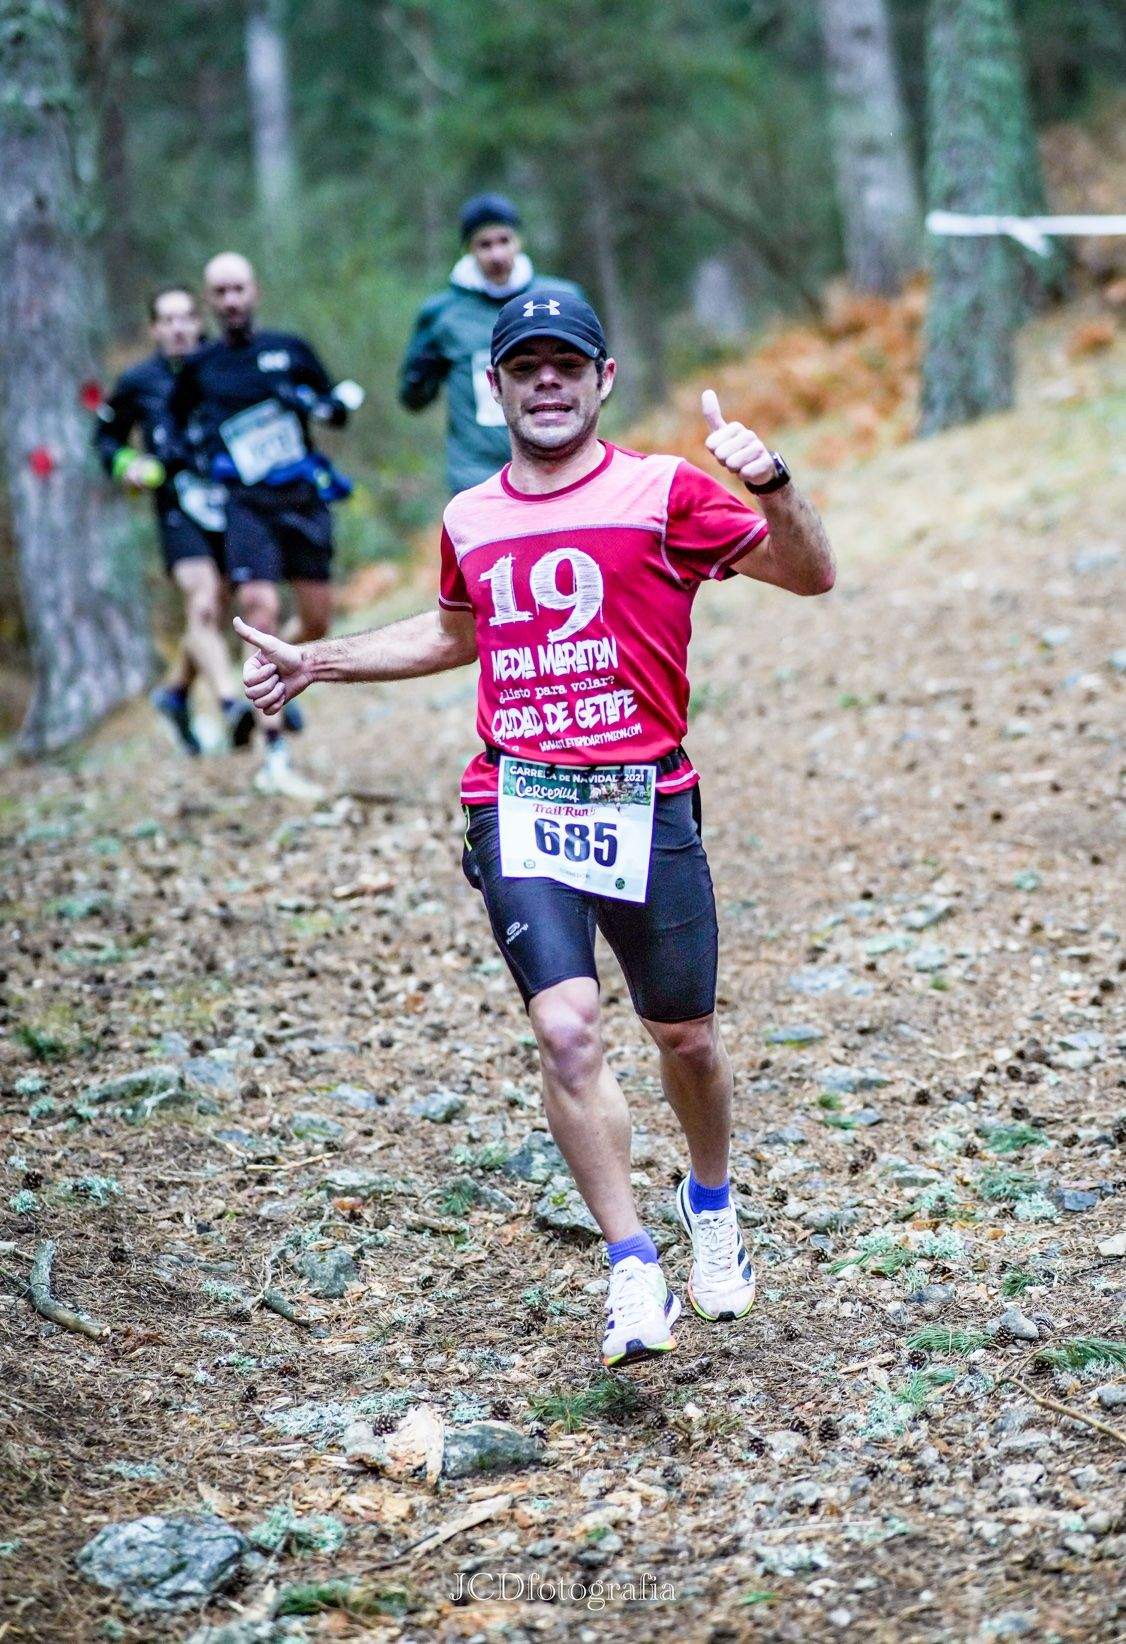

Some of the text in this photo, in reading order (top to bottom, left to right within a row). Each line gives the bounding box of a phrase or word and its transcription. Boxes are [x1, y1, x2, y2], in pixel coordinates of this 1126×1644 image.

[479, 547, 604, 643] 19
[491, 636, 619, 682] MEDIA MARATON
[499, 675, 616, 704] ¿listo para volar?
[490, 689, 639, 740] CIUDAD DE GETAFE
[509, 766, 557, 781] CARREA
[558, 773, 571, 783] DE
[623, 772, 645, 783] 2021
[532, 802, 562, 816] Trail
[534, 817, 618, 868] 685
